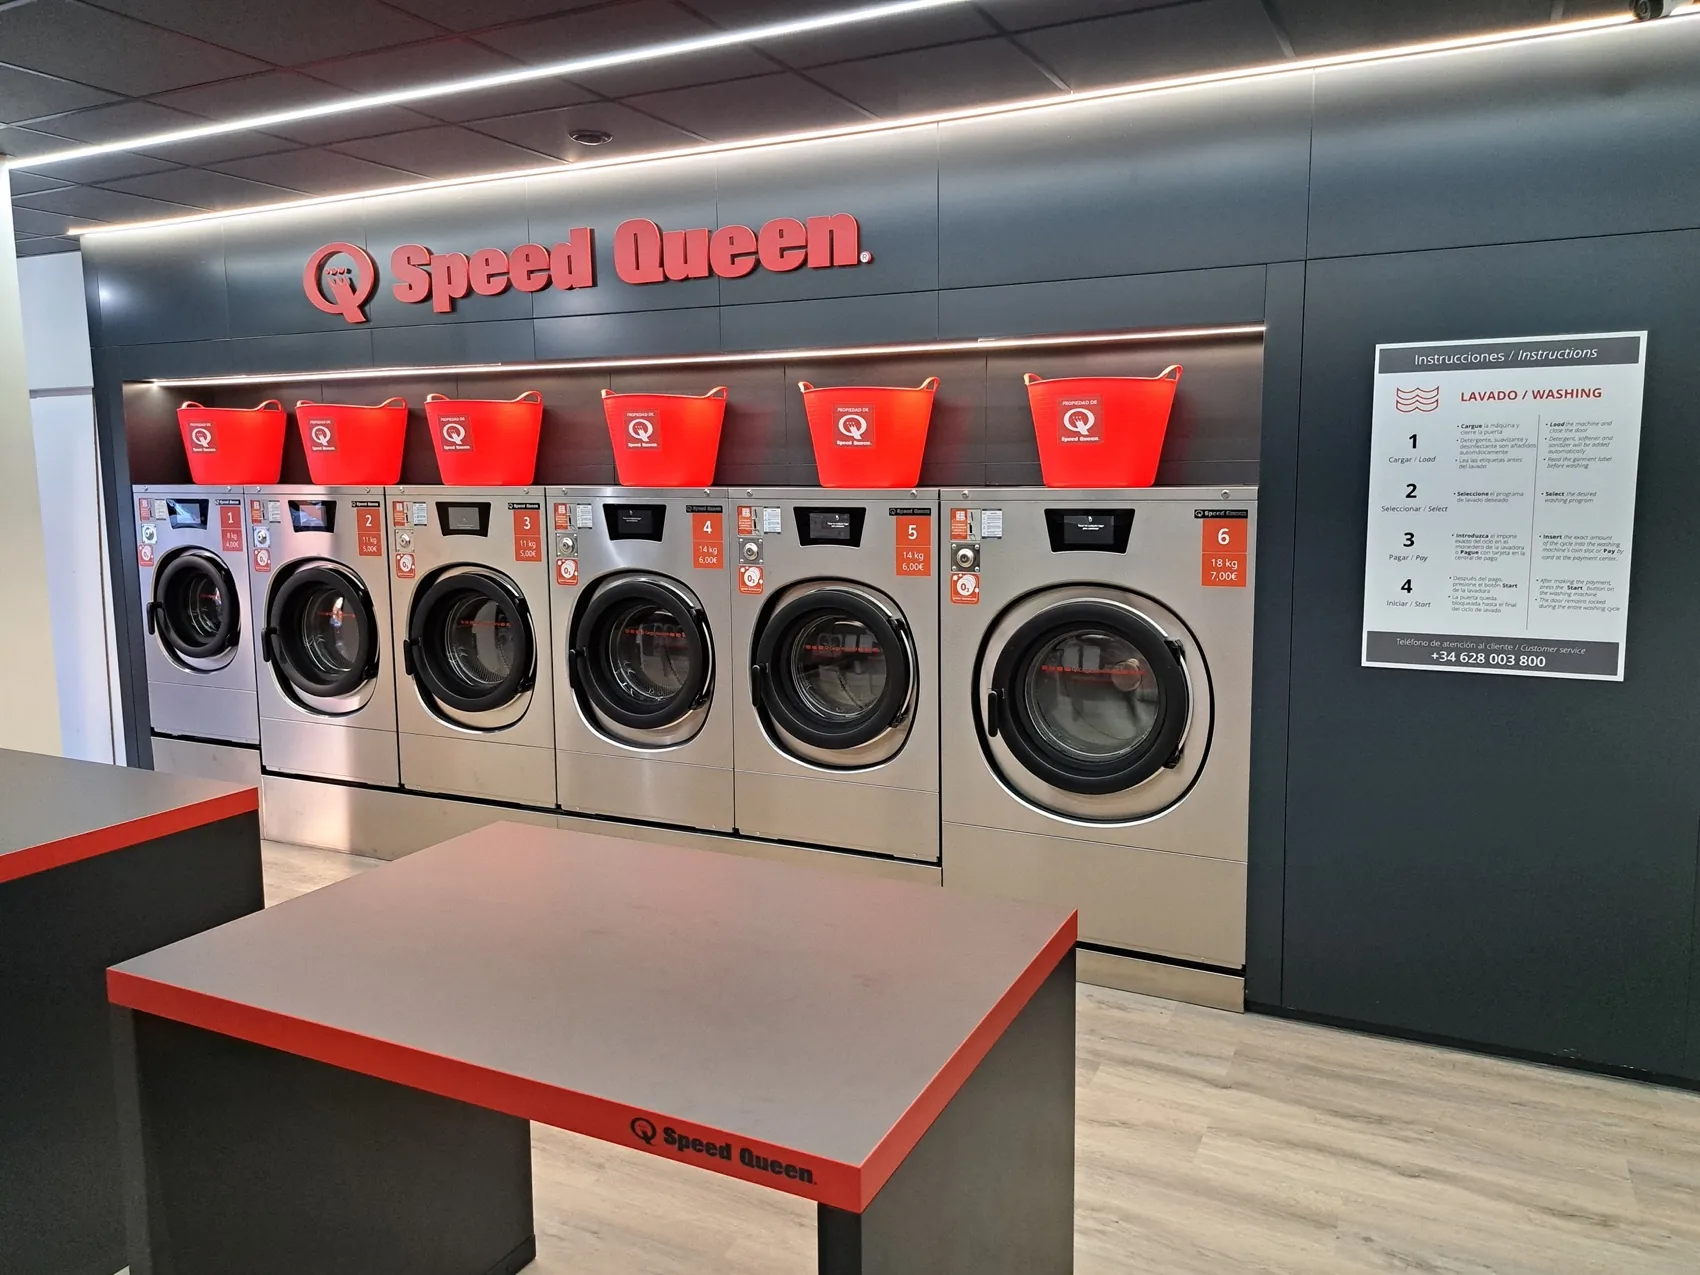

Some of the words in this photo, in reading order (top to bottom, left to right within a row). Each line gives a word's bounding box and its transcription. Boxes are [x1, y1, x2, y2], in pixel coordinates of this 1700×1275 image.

[391, 227, 595, 313] Speed
[613, 212, 860, 285] Queen
[1415, 352, 1504, 365] Instrucciones
[1509, 350, 1514, 361] /
[1518, 347, 1598, 361] Instructions
[1461, 390, 1517, 402] LAVADO
[1522, 390, 1527, 400] /
[1532, 388, 1602, 399] WASHING
[1409, 434, 1417, 449] 1
[1406, 483, 1417, 498] 2
[228, 512, 233, 523] 1
[365, 515, 372, 527] 2
[524, 517, 530, 530] 3
[703, 520, 712, 534] 4
[908, 525, 917, 539] 5
[1218, 528, 1230, 545] 6
[1403, 532, 1415, 547] 3
[528, 540, 536, 549] kg
[710, 546, 717, 554] kg
[520, 550, 536, 558] 5,00€
[915, 551, 924, 561] kg
[1389, 554, 1409, 562] Pagar
[902, 563, 924, 571] 6,00€
[1212, 559, 1223, 567] 18
[1226, 559, 1237, 570] kg
[1211, 572, 1237, 581] 7,00€
[1400, 579, 1413, 594] 4
[1397, 638, 1429, 647] Teléfono
[1442, 641, 1475, 649] atención
[1478, 642, 1484, 650] al
[1521, 644, 1557, 653] Customer
[1431, 651, 1455, 662] +34
[1460, 652, 1485, 664] 628
[1490, 654, 1515, 665] 003
[1519, 655, 1545, 667] 800
[663, 1127, 732, 1161] Speed
[739, 1147, 813, 1184] Queen
